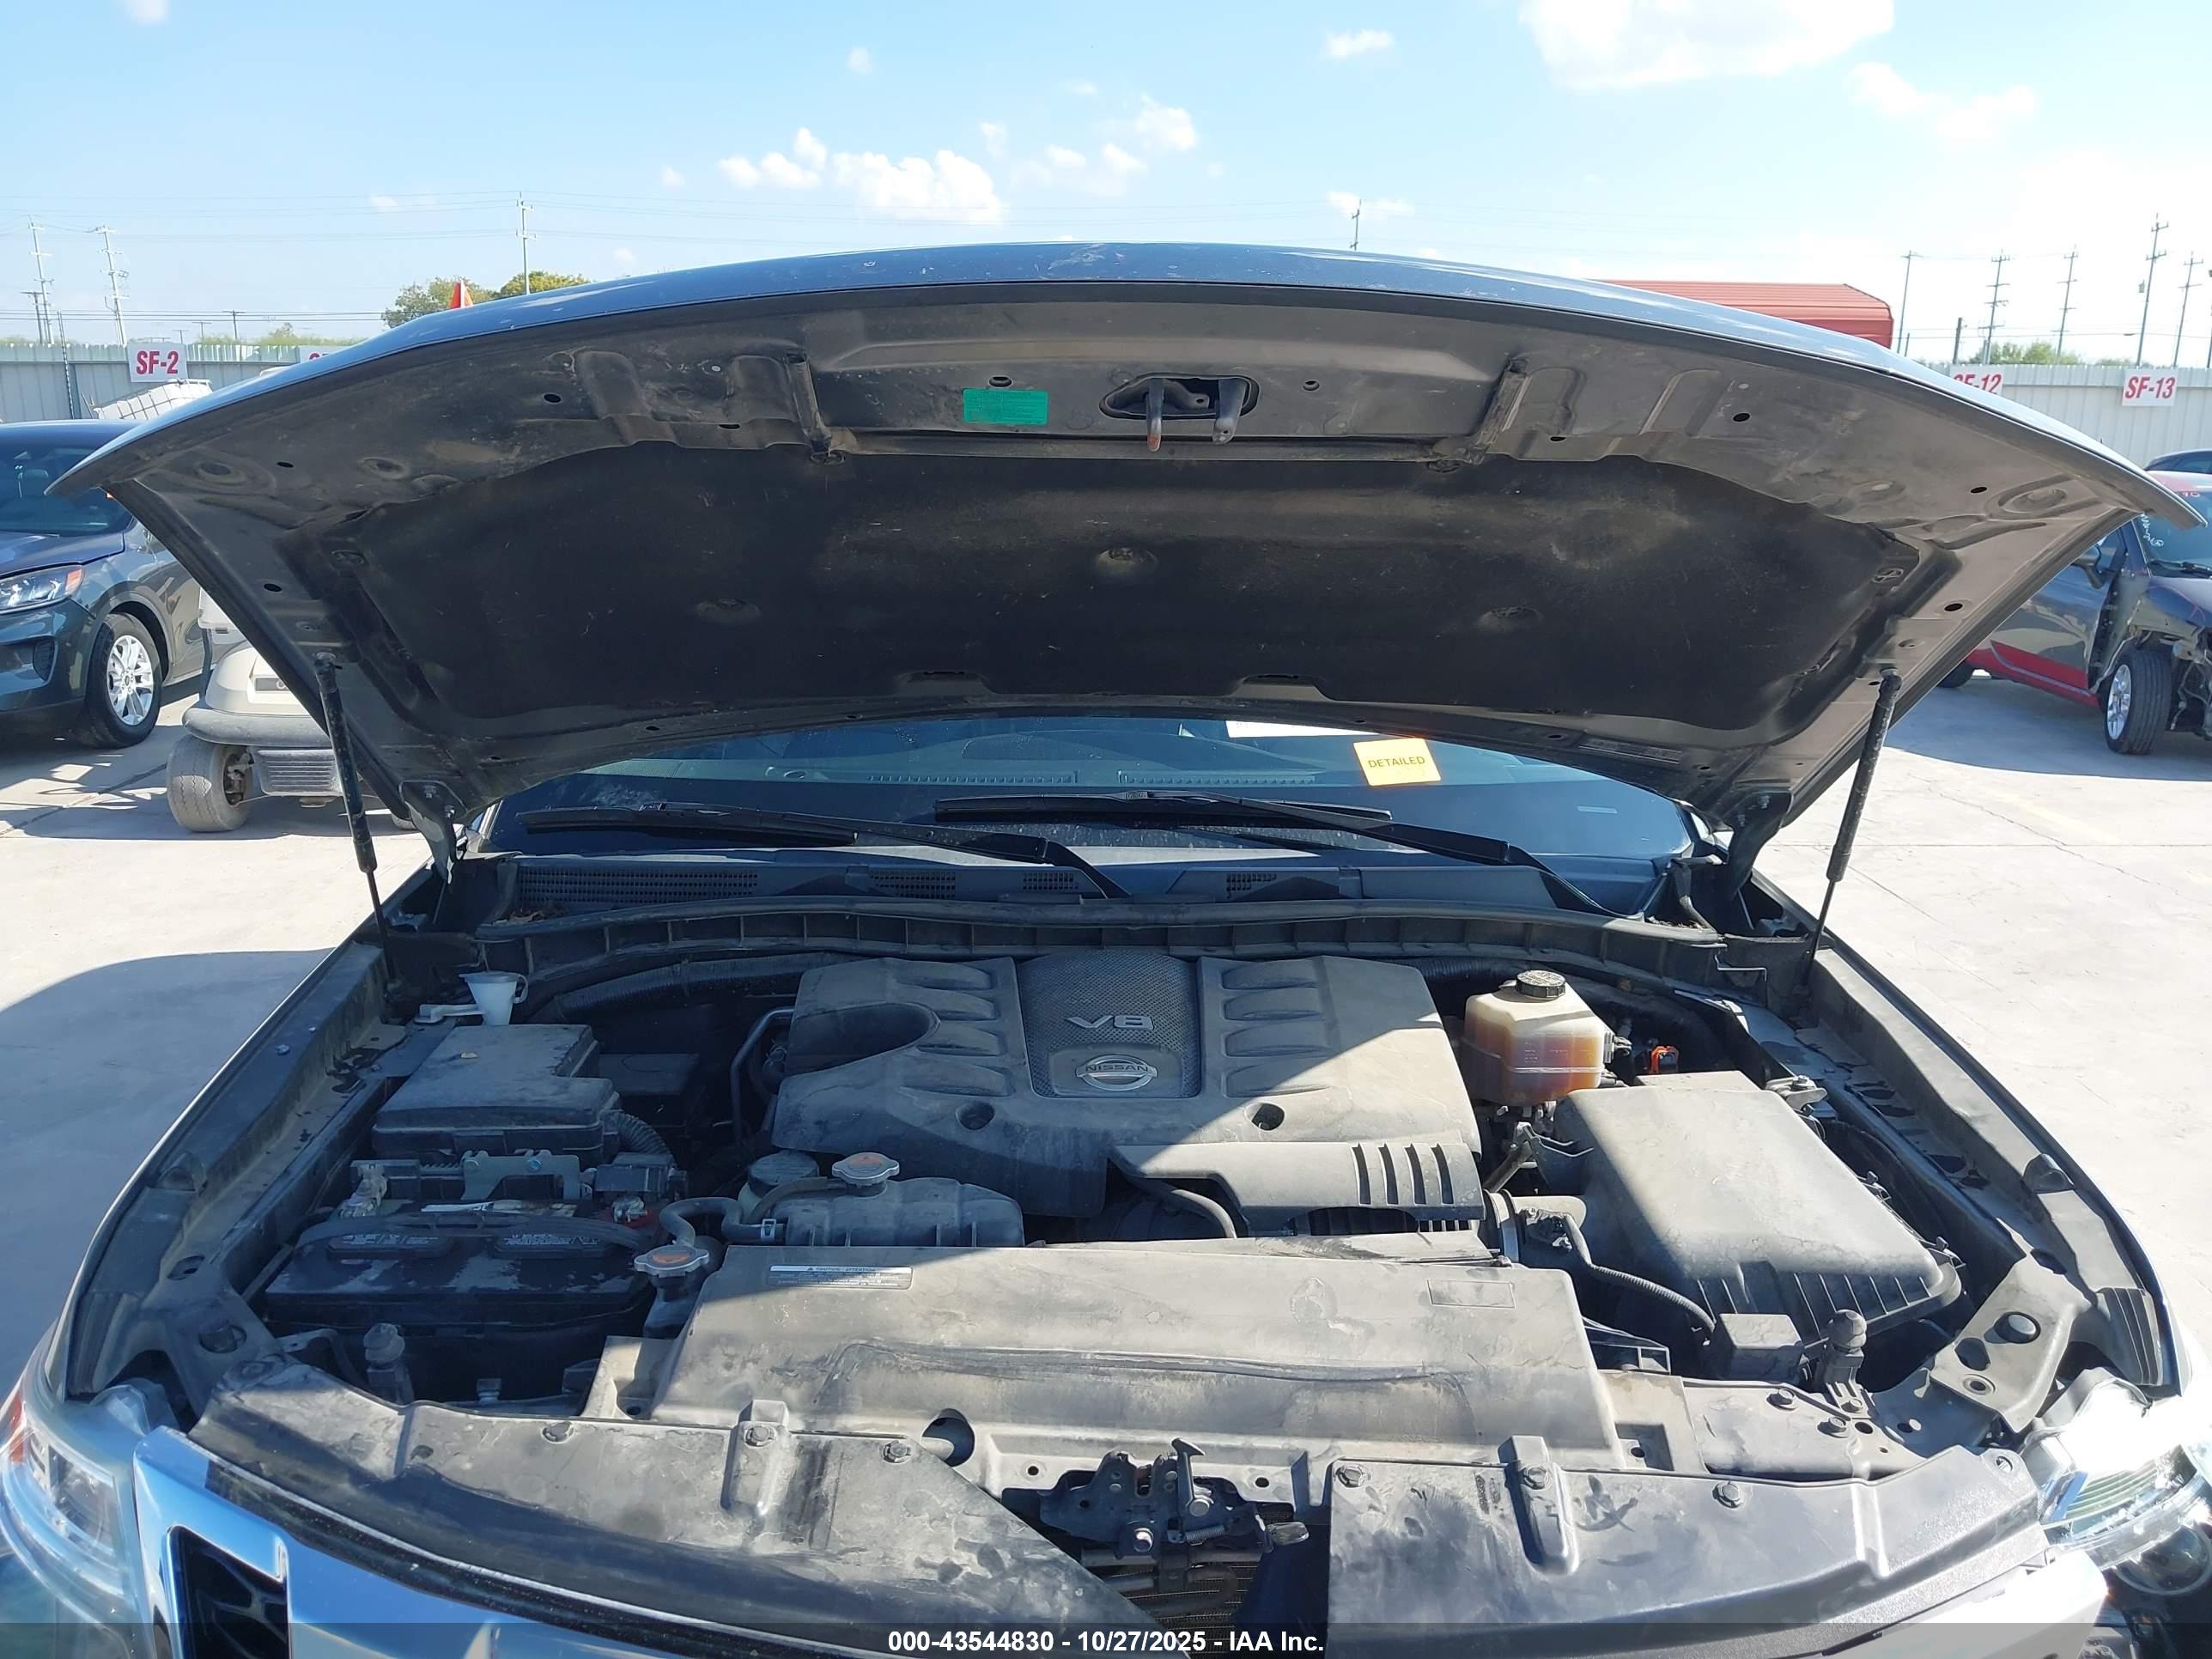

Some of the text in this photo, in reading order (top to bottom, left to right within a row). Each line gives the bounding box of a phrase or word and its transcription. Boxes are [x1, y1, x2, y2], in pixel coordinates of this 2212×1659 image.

[136, 350, 179, 374] SF-2
[2124, 375, 2176, 399] SF-13
[1367, 756, 1425, 768] DETAILED
[1067, 1015, 1154, 1030] V8
[1085, 1064, 1149, 1073] NISSAN
